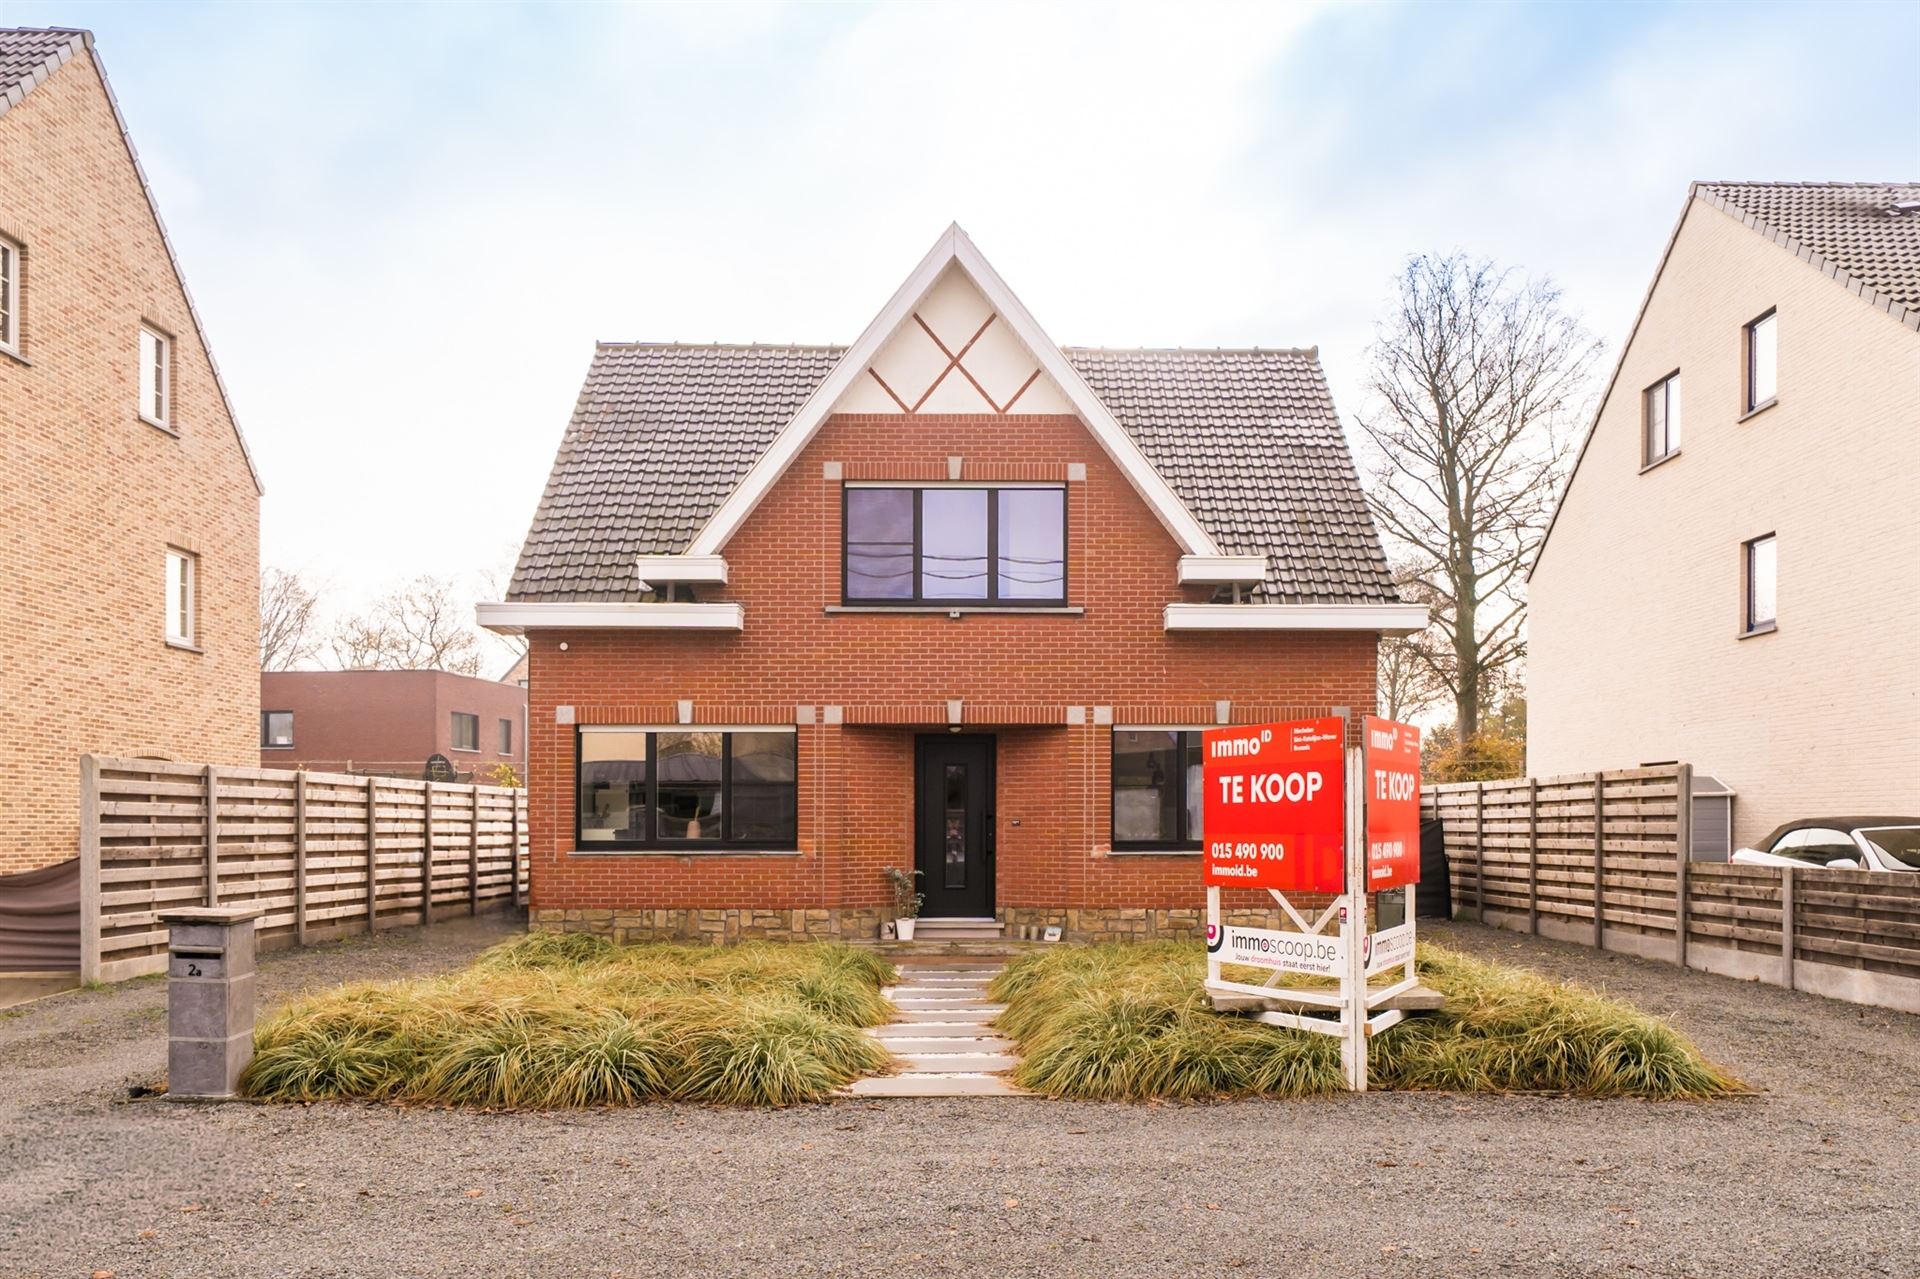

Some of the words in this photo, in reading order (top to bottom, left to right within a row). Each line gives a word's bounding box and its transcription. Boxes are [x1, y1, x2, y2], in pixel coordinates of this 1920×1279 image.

[1219, 775, 1244, 803] TE
[1251, 771, 1323, 803] KOOP
[1375, 769, 1387, 800] TE
[1388, 771, 1415, 801] KOOP
[1211, 842, 1232, 859] 015
[1235, 843, 1257, 859] 490
[1260, 843, 1284, 860] 900
[1211, 864, 1258, 877] immoid.be
[1231, 930, 1336, 961] immoscoop.be
[188, 964, 202, 977] 2a
[1282, 960, 1298, 969] staat
[1299, 963, 1316, 972] eerst
